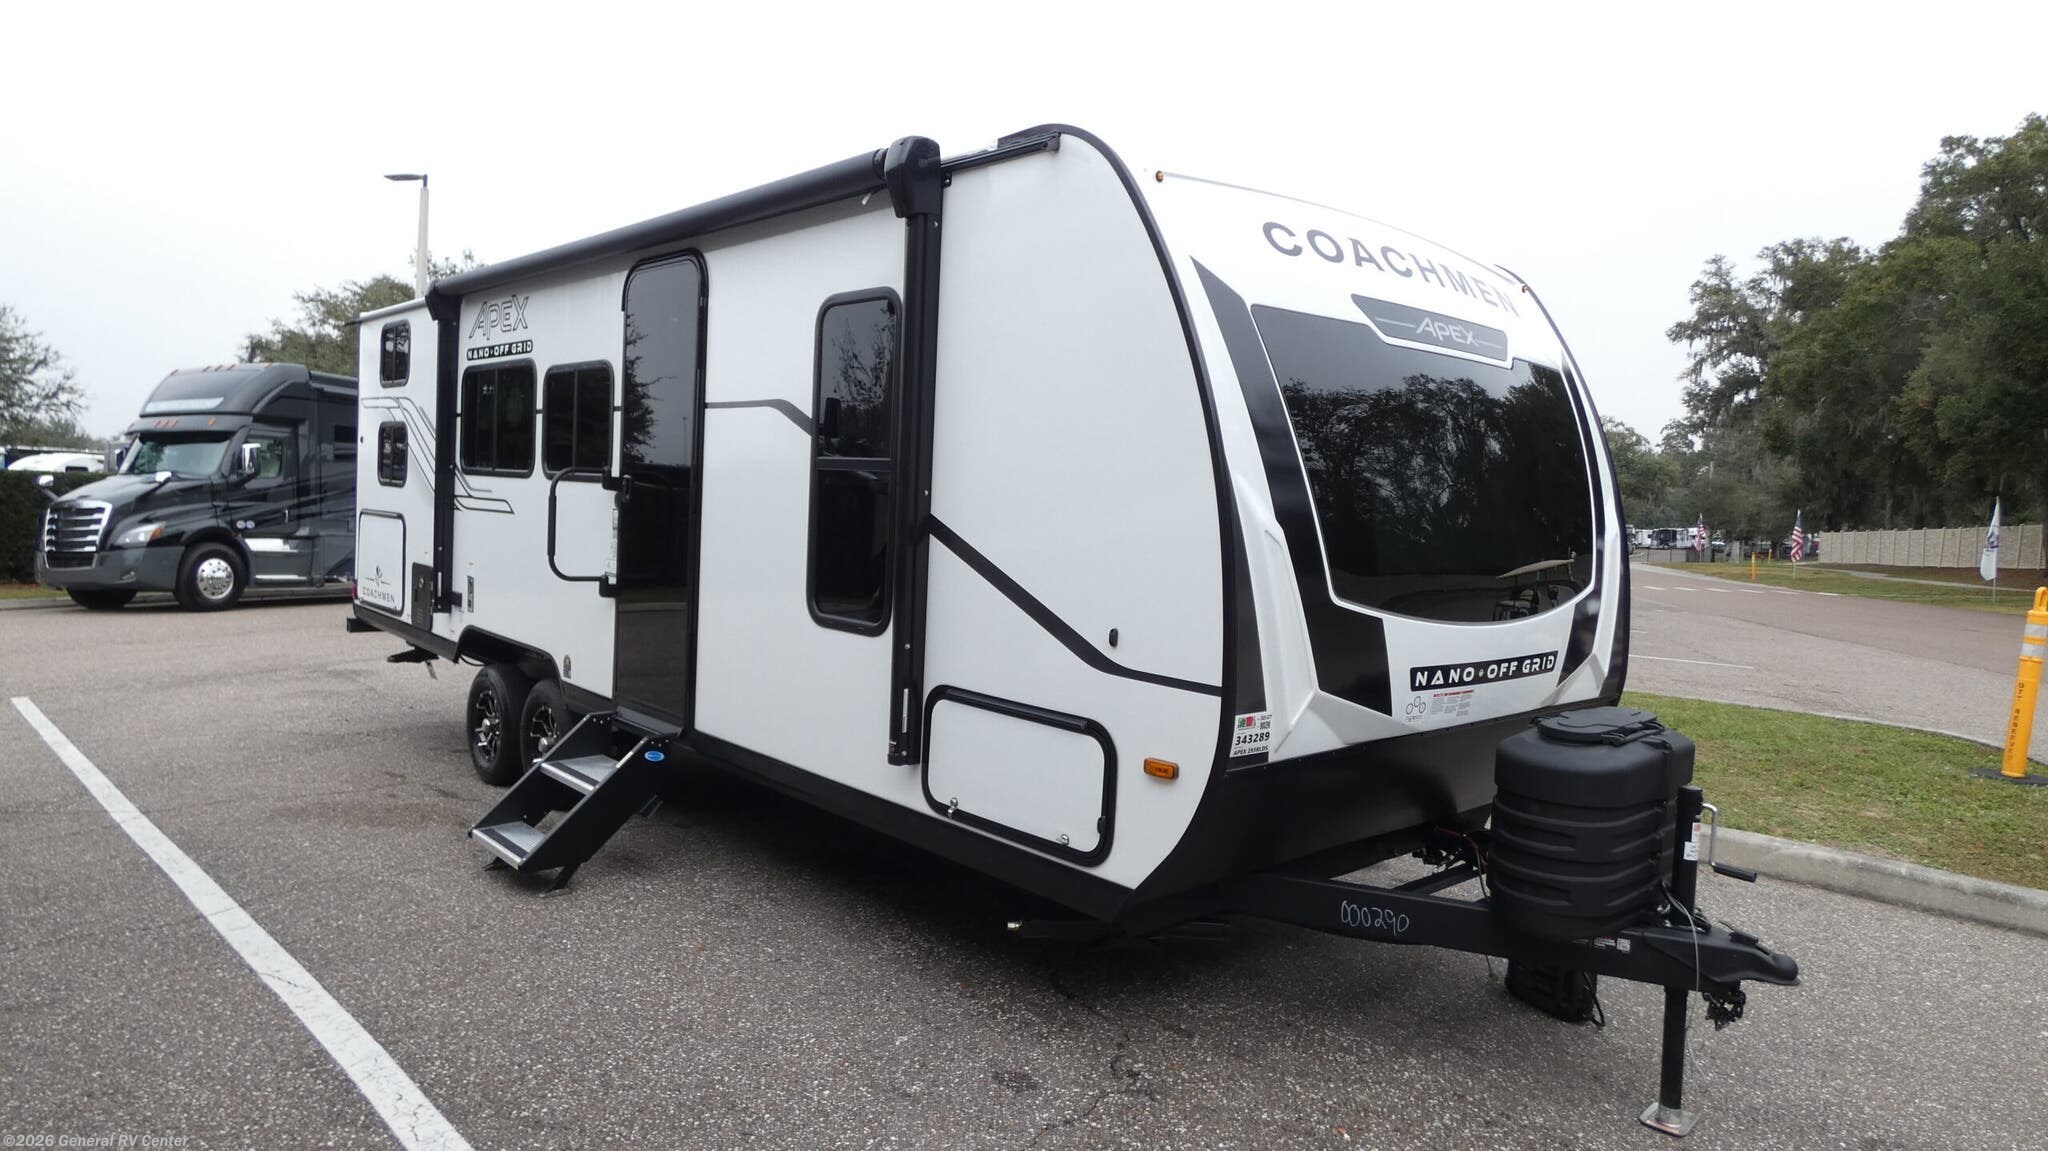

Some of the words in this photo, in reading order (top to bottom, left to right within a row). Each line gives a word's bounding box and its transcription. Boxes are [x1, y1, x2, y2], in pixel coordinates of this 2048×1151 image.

[1262, 221, 1521, 318] COACHMEN
[469, 294, 529, 340] APEX
[1415, 317, 1478, 346] APEX
[467, 348, 489, 360] NANO
[494, 344, 510, 356] OFF
[511, 341, 532, 353] GRID
[363, 586, 395, 602] COACHMEN
[1415, 667, 1475, 687] NANO
[1487, 661, 1518, 679] OFF
[1522, 655, 1555, 674] GRID
[1235, 732, 1270, 746] 343289
[1341, 900, 1410, 936] 000290
